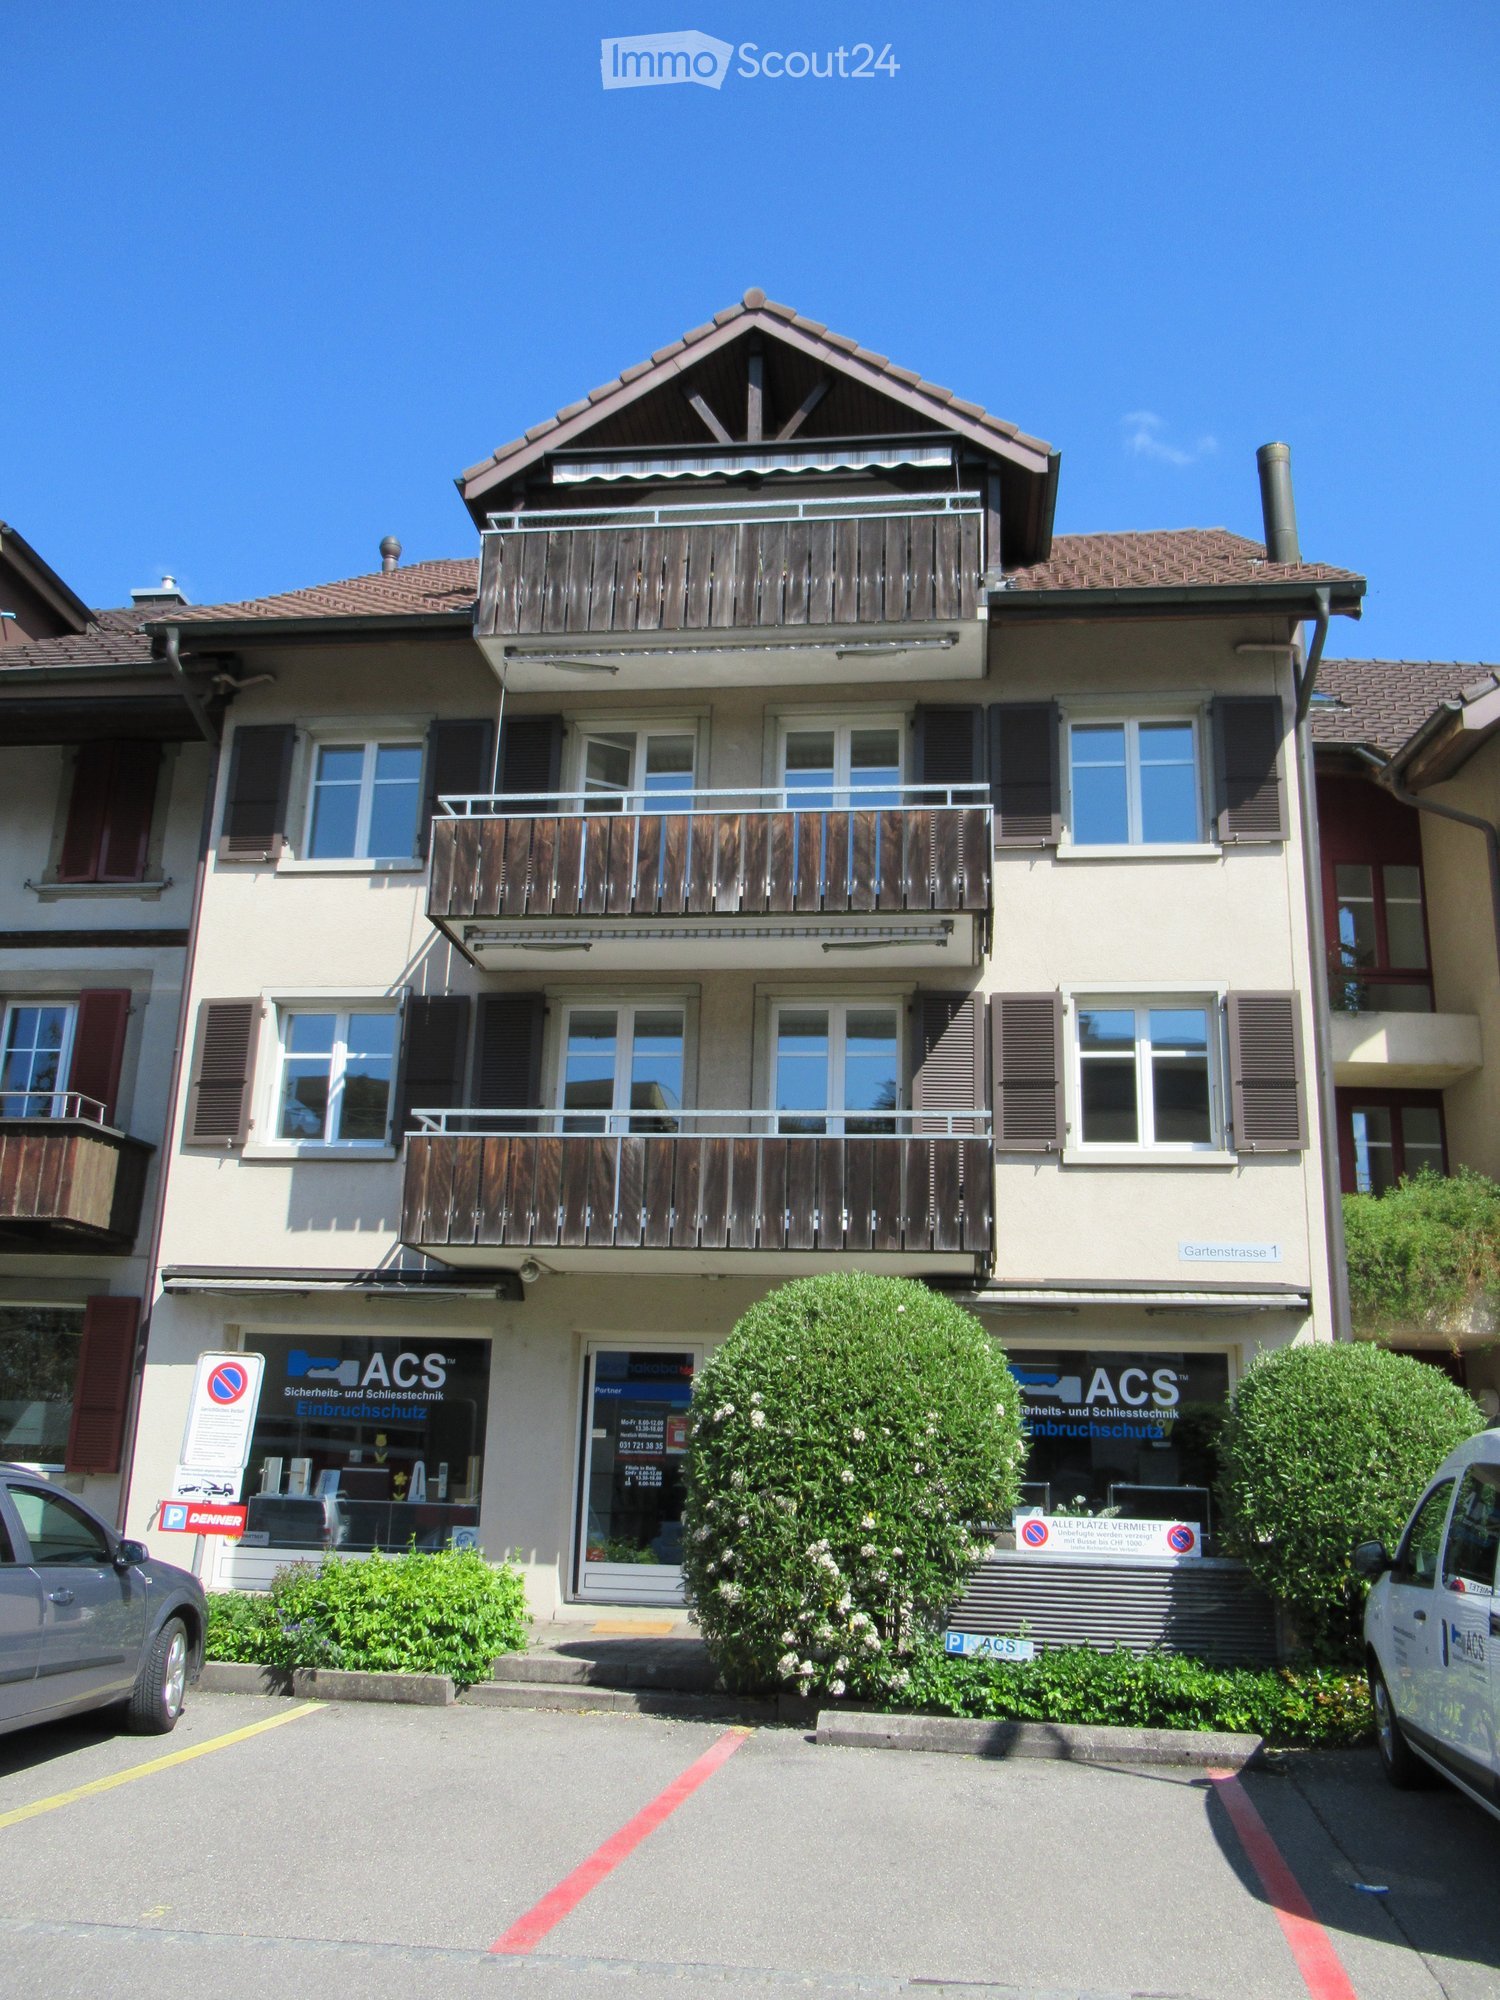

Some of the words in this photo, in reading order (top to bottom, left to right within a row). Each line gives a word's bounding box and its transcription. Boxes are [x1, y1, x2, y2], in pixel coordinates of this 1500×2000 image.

[1184, 1245, 1267, 1258] Gartenstrasse
[1271, 1245, 1277, 1258] 1
[360, 1352, 446, 1388] ACS
[284, 1386, 342, 1397] Sicherheits-
[345, 1388, 363, 1398] und
[366, 1389, 444, 1400] Schliesstechnik
[595, 1386, 622, 1395] Partner
[1085, 1368, 1180, 1406] ACS
[296, 1401, 427, 1420] Einbruchschutz
[1068, 1407, 1089, 1416] und
[1093, 1407, 1179, 1419] Schliesstechnik
[620, 1441, 631, 1449] 031
[646, 1442, 654, 1450] 38
[167, 1508, 183, 1526] P
[189, 1513, 243, 1526] DENNER
[1052, 1520, 1073, 1528] ALLE
[1076, 1519, 1109, 1530] PLÄTZE
[1112, 1522, 1163, 1532] VERMIETET
[948, 1634, 960, 1650] P
[983, 1638, 1016, 1652] ACS
[1466, 1630, 1485, 1662] ACS
